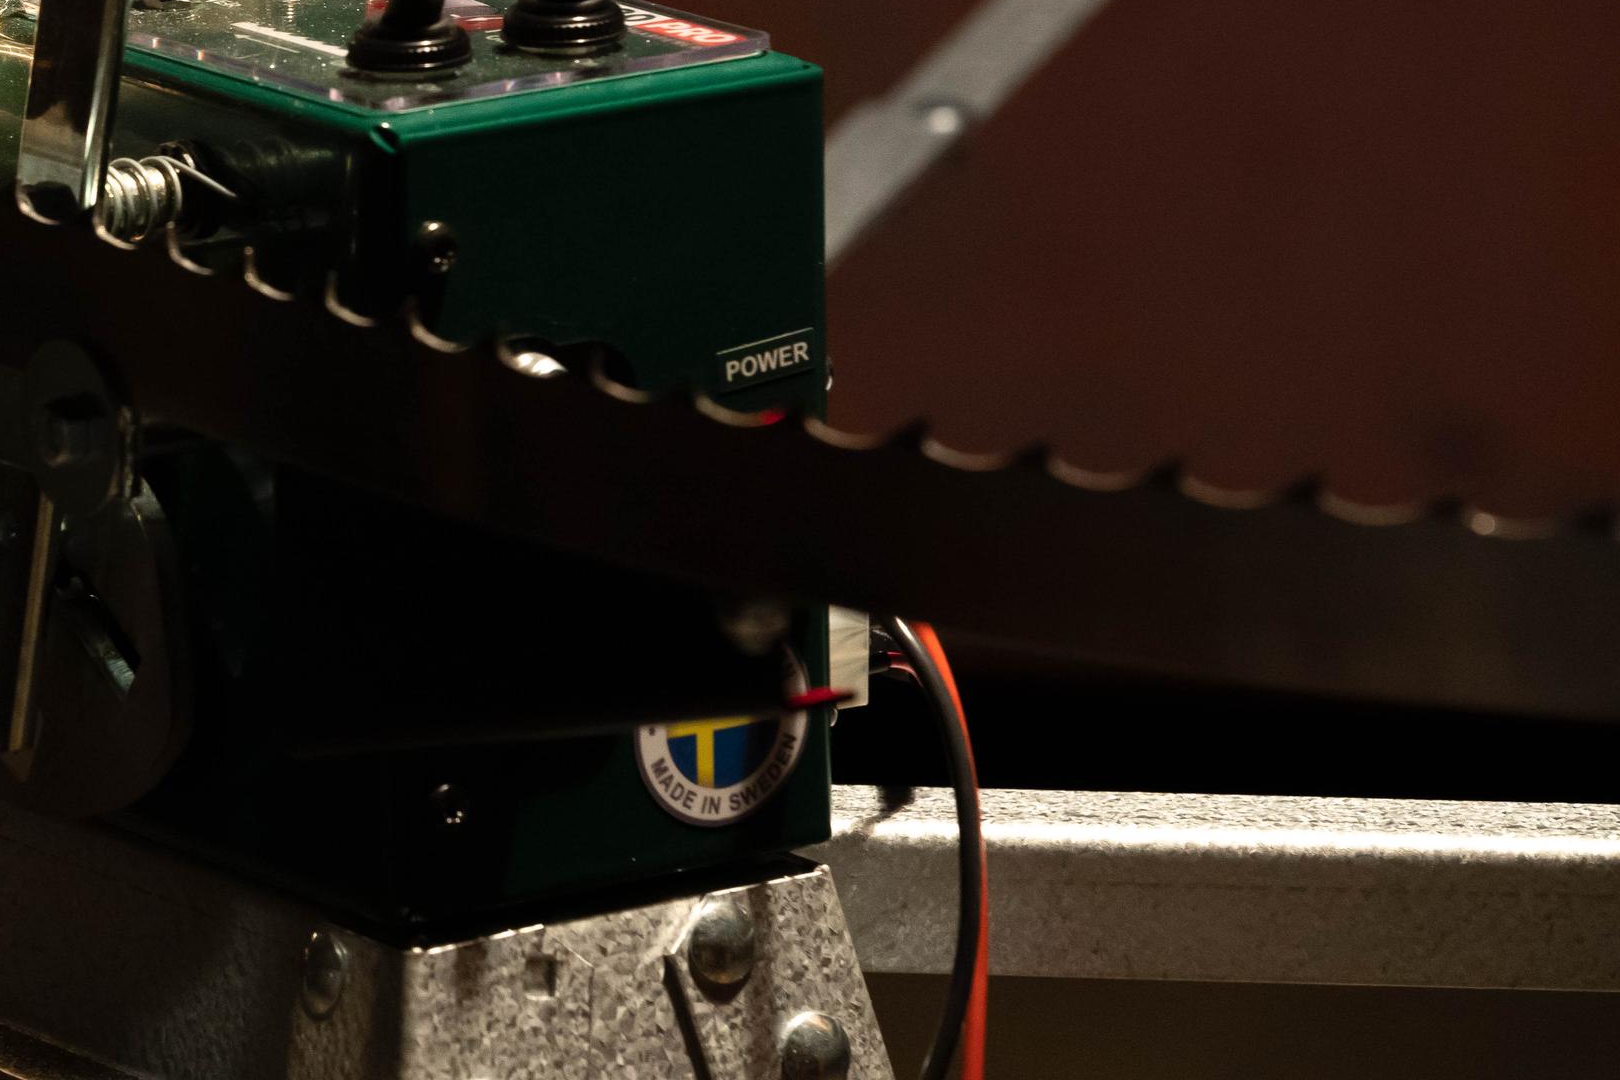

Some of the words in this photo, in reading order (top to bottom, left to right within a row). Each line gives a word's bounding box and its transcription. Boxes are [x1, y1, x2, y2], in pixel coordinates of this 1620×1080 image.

[725, 341, 810, 383] POWER
[650, 756, 697, 811] MADE
[701, 795, 722, 815] IN
[729, 732, 798, 812] SWEDEN
